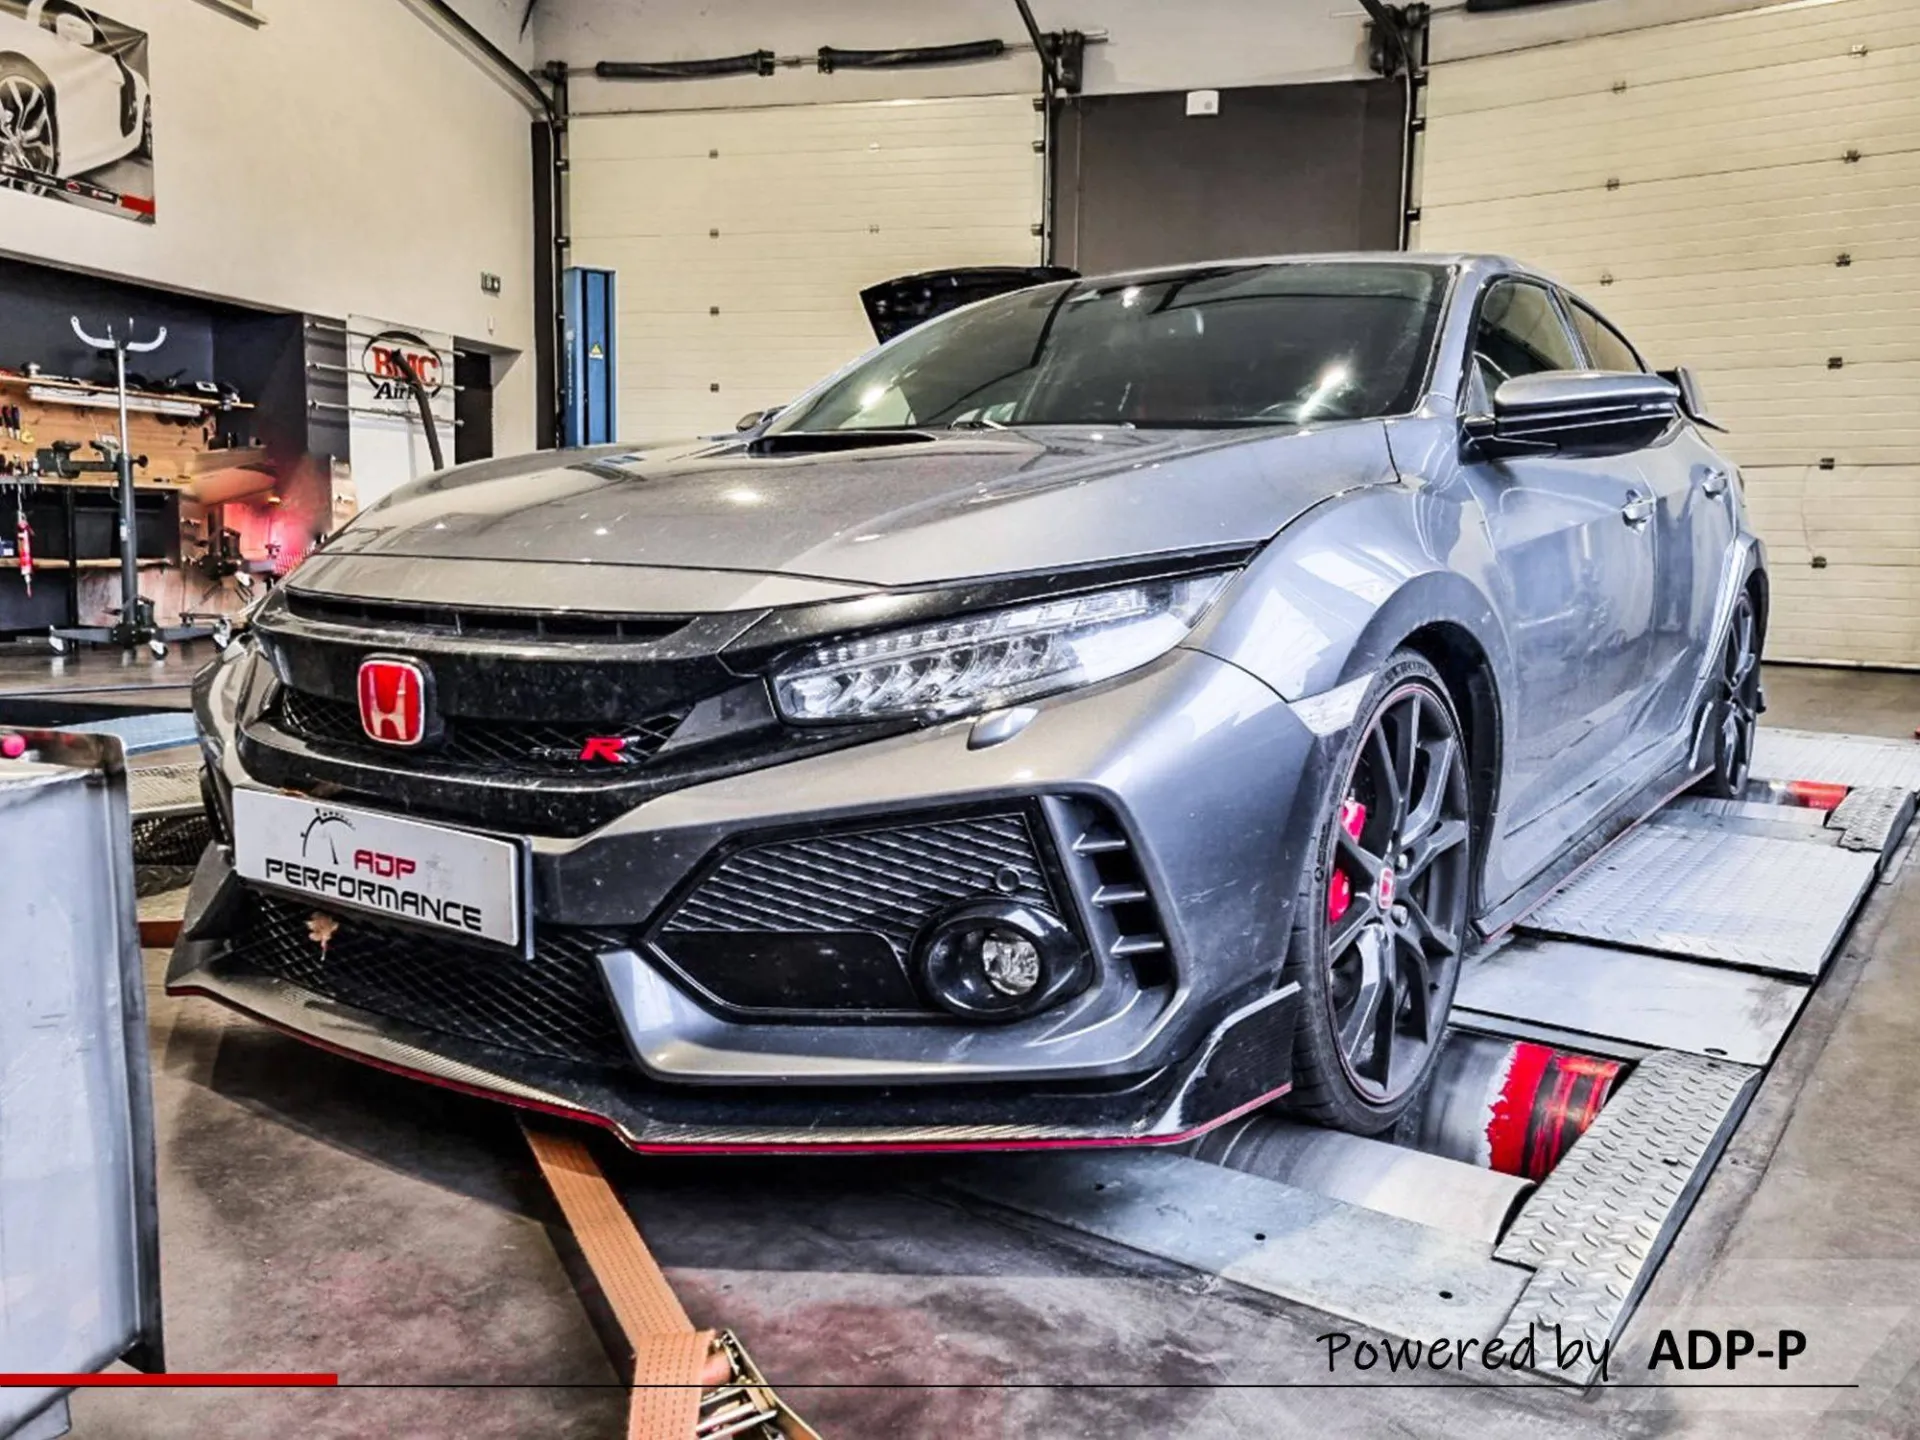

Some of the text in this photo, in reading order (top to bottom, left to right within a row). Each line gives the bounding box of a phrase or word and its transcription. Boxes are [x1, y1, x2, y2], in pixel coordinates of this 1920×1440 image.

[579, 735, 639, 764] R
[353, 849, 416, 880] ADP
[264, 857, 482, 932] PERFORMANCE
